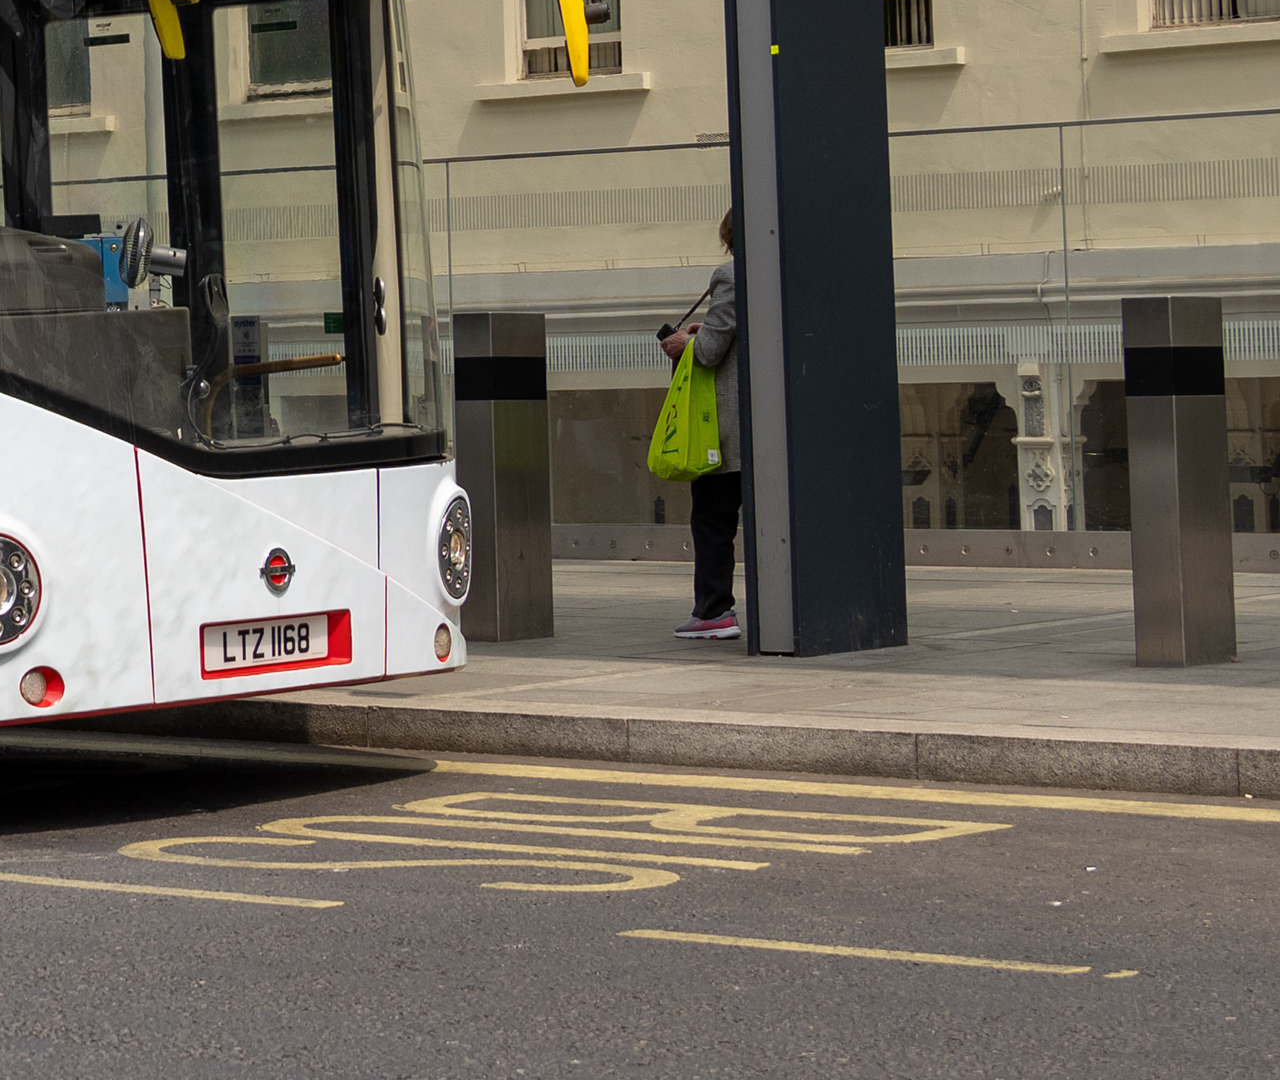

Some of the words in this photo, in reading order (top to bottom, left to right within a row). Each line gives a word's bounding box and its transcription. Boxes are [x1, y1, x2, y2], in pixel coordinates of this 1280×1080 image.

[222, 627, 265, 663] LTZ
[271, 622, 310, 657] 1168
[116, 791, 1013, 893] BUS
